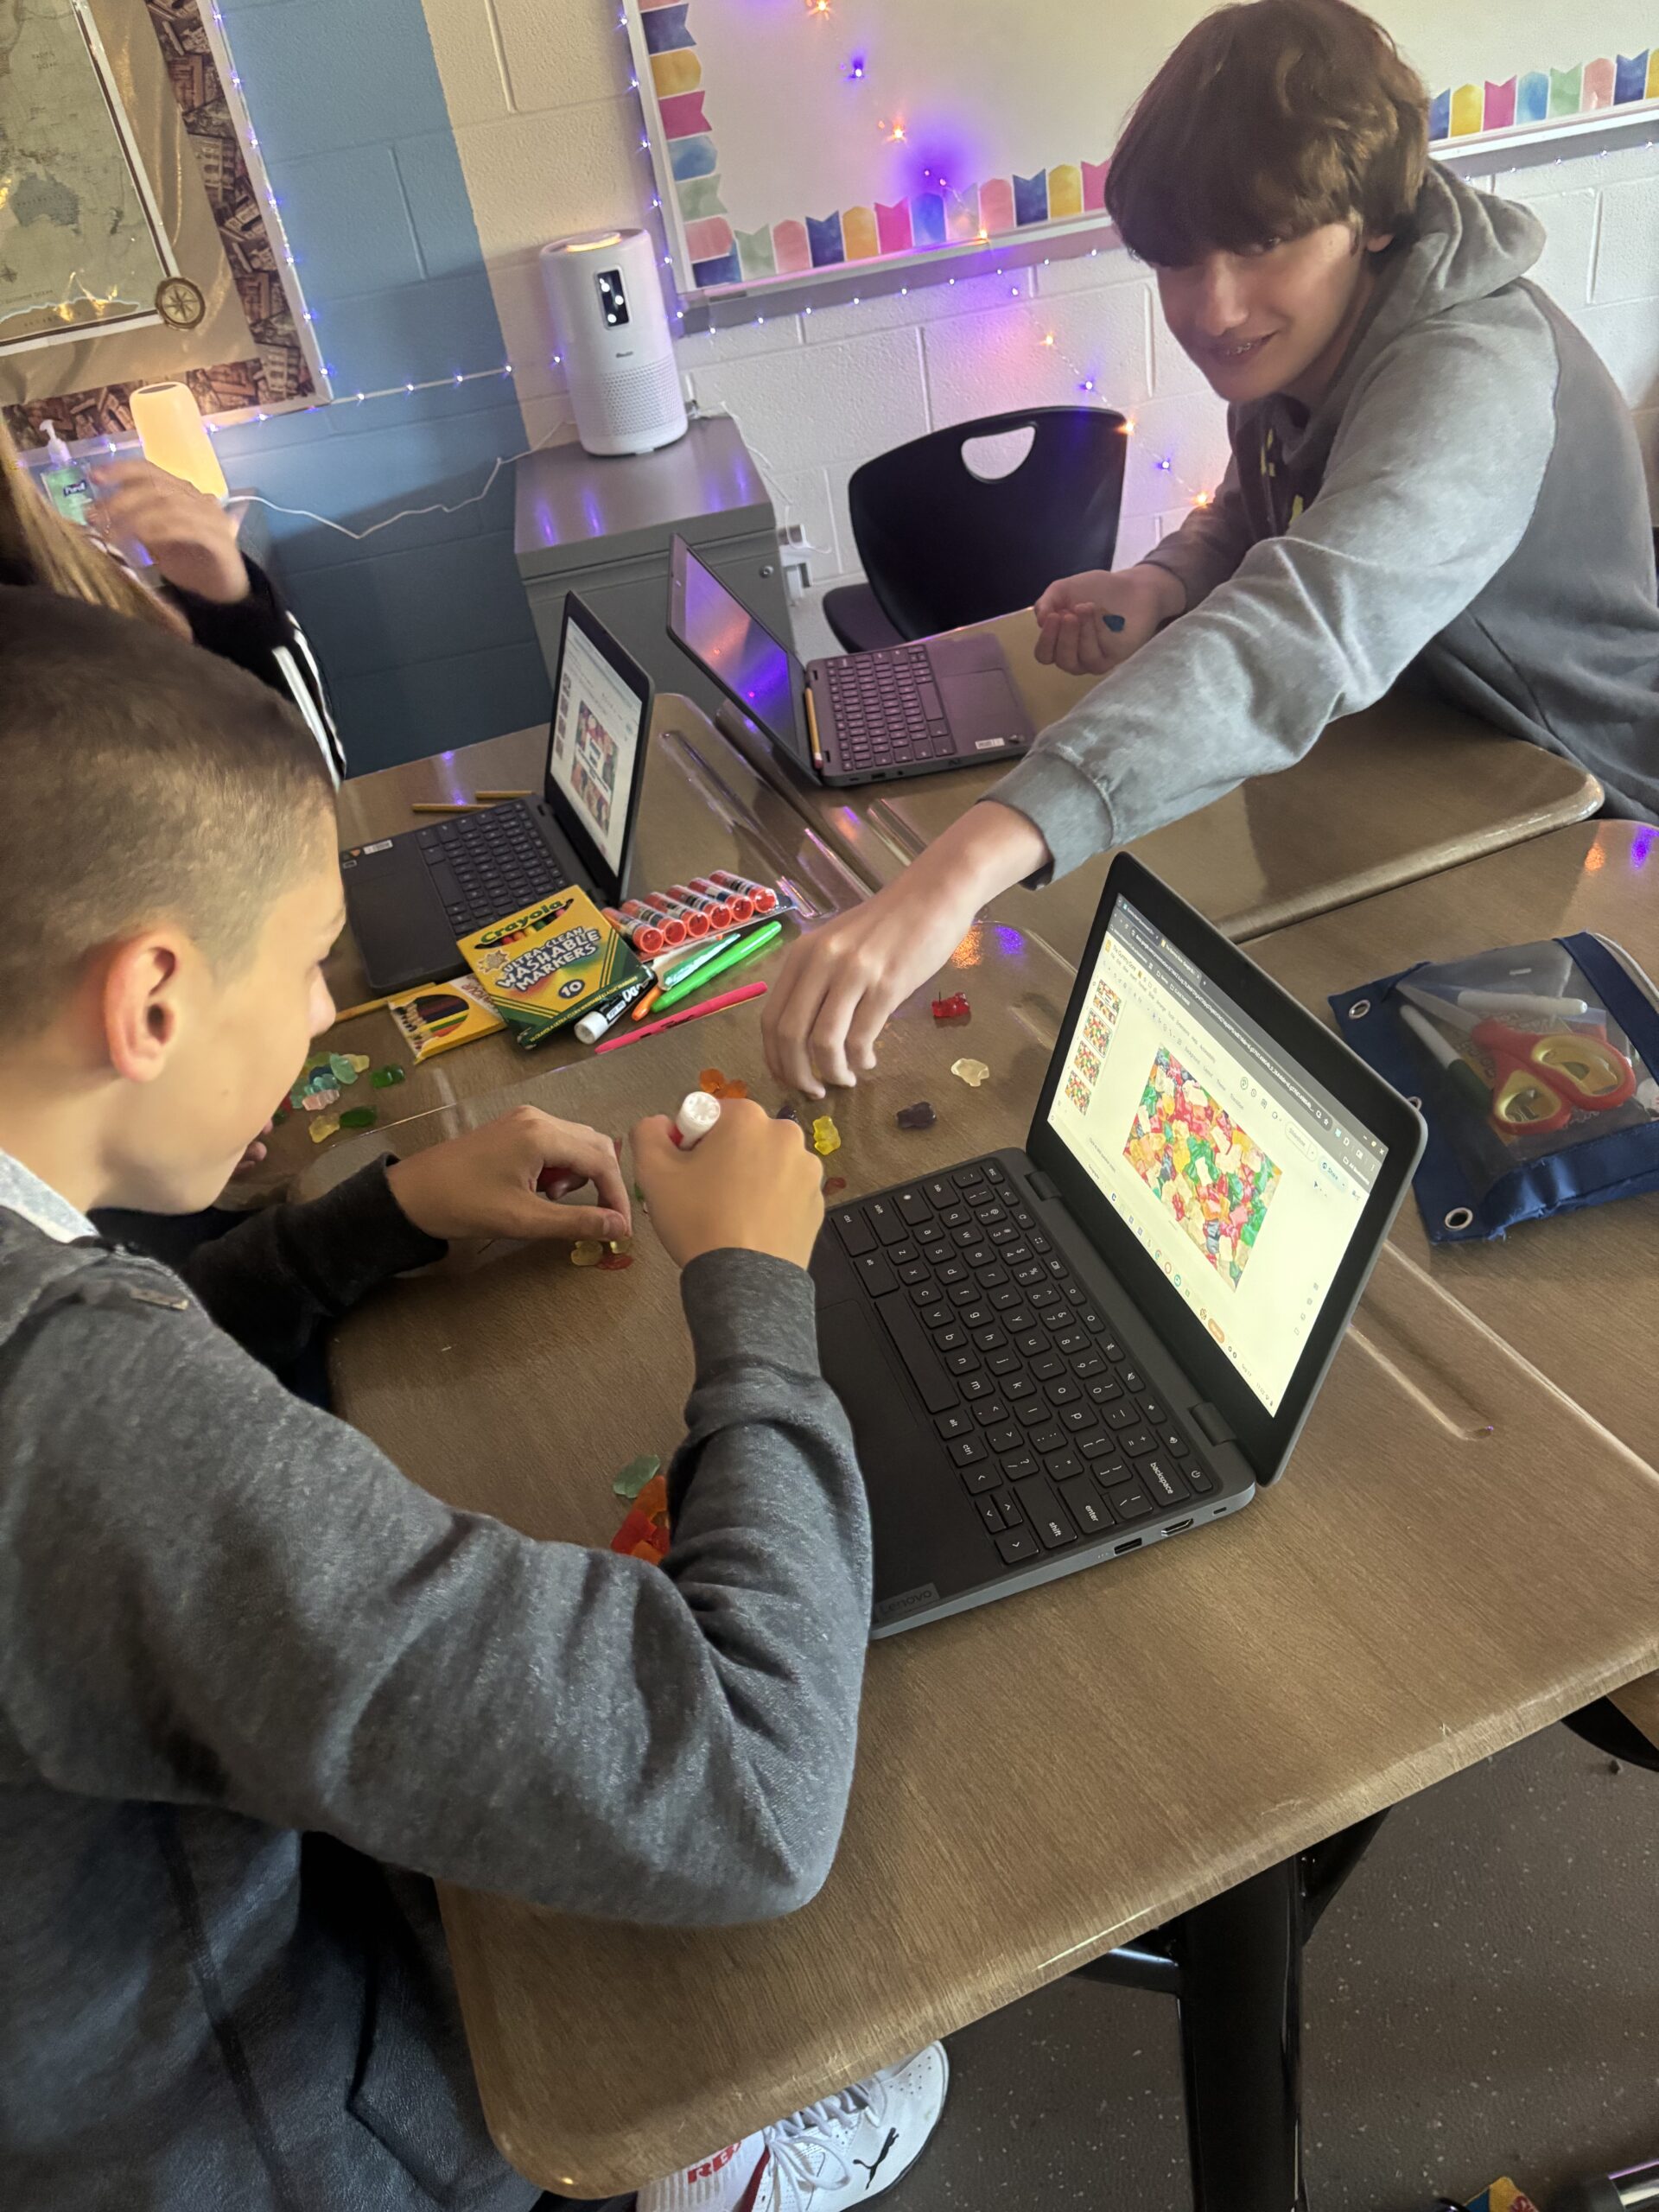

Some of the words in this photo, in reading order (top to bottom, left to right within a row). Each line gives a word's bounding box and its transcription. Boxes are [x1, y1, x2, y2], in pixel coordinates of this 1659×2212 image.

[480, 899, 564, 944] Crayola
[496, 928, 601, 988] WASHABLE
[503, 926, 585, 973] ULTRA-CLEAN
[515, 943, 598, 992] MARKERS
[560, 981, 582, 996] 10
[934, 1184, 943, 1192] tab
[874, 1205, 884, 1214] shift
[843, 1215, 853, 1224] ctrl
[963, 1444, 973, 1455] ctrl
[1150, 1461, 1173, 1495] backspace
[1084, 1504, 1099, 1522] enter
[1049, 1522, 1062, 1537] shift
[880, 1590, 932, 1613] Lenovo
